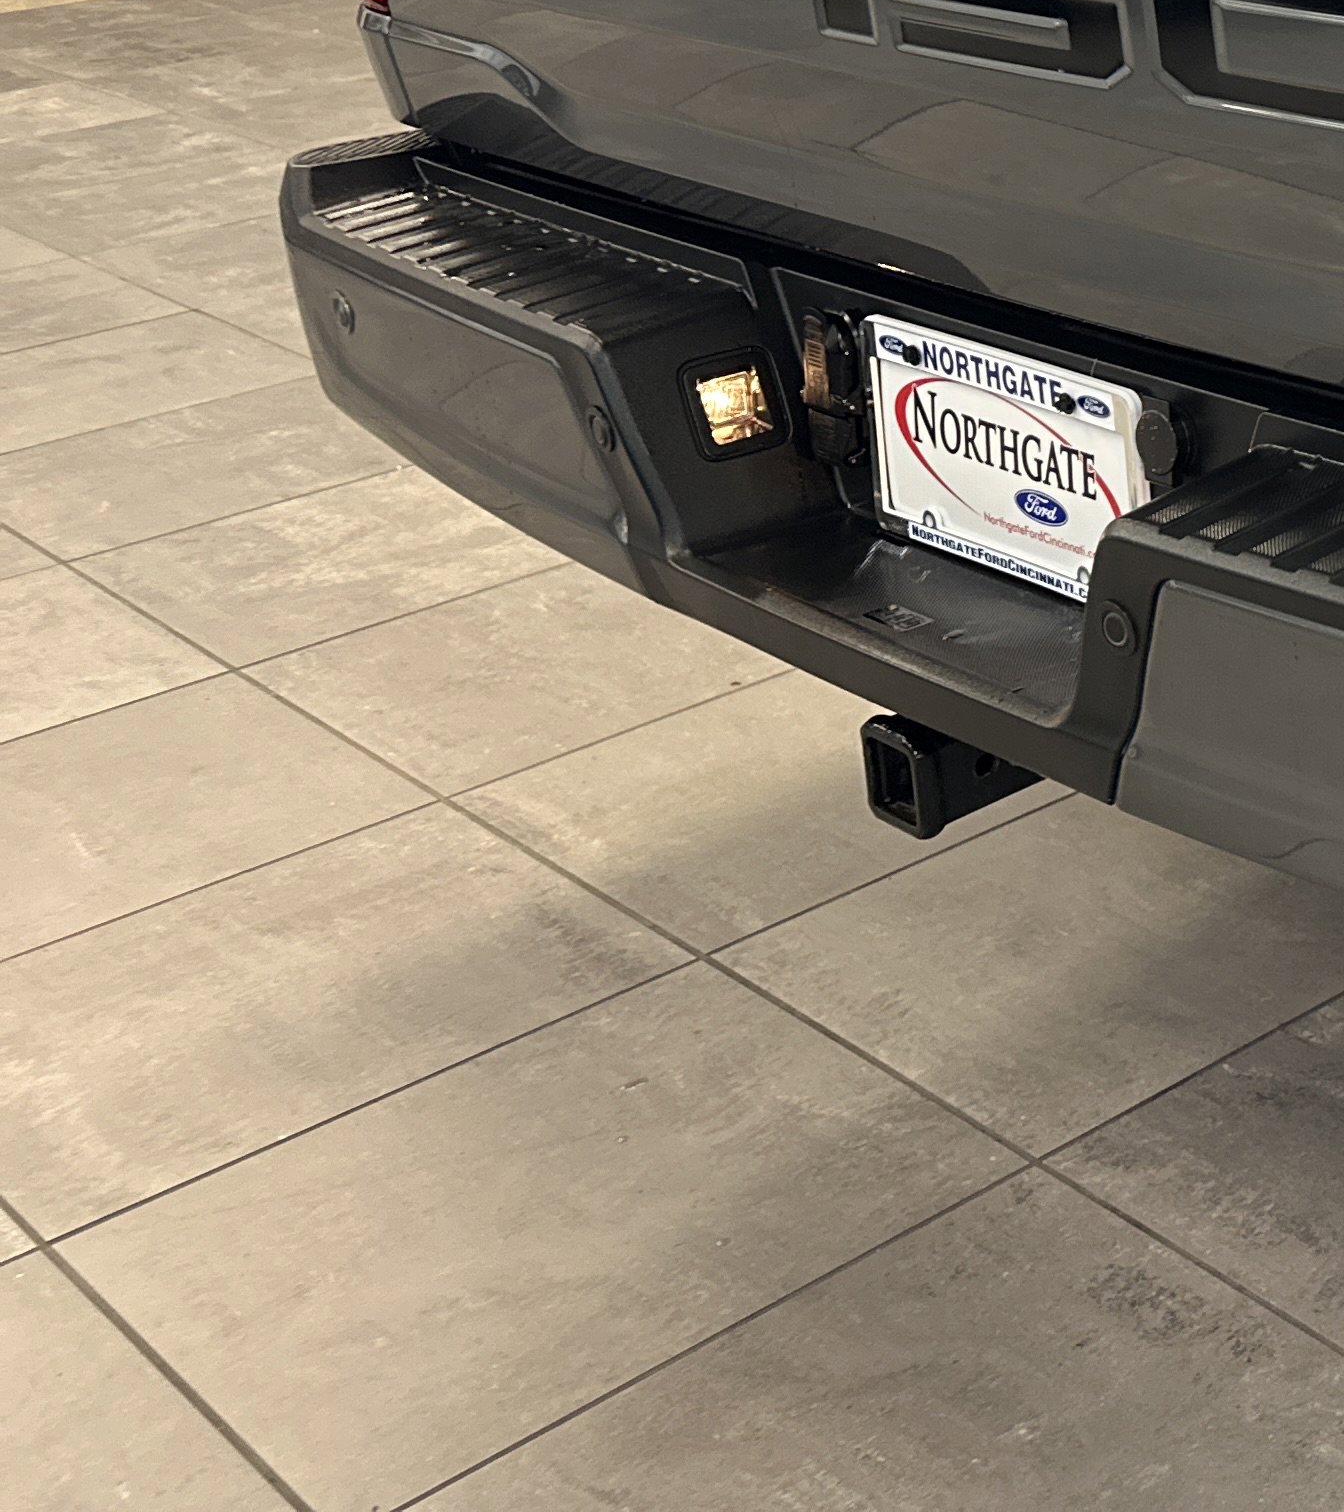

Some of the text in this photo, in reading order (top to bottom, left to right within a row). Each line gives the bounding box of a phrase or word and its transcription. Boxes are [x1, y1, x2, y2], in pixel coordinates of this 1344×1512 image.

[922, 340, 1064, 406] NORTHGATE
[1083, 396, 1105, 414] Ford
[912, 384, 1098, 501] NORTHGATE
[983, 511, 1095, 559] NorthgateFordCincinnati.c
[1024, 495, 1058, 522] Ford
[911, 524, 1088, 599] NORTHGATEFORDCINCINNATI.C
